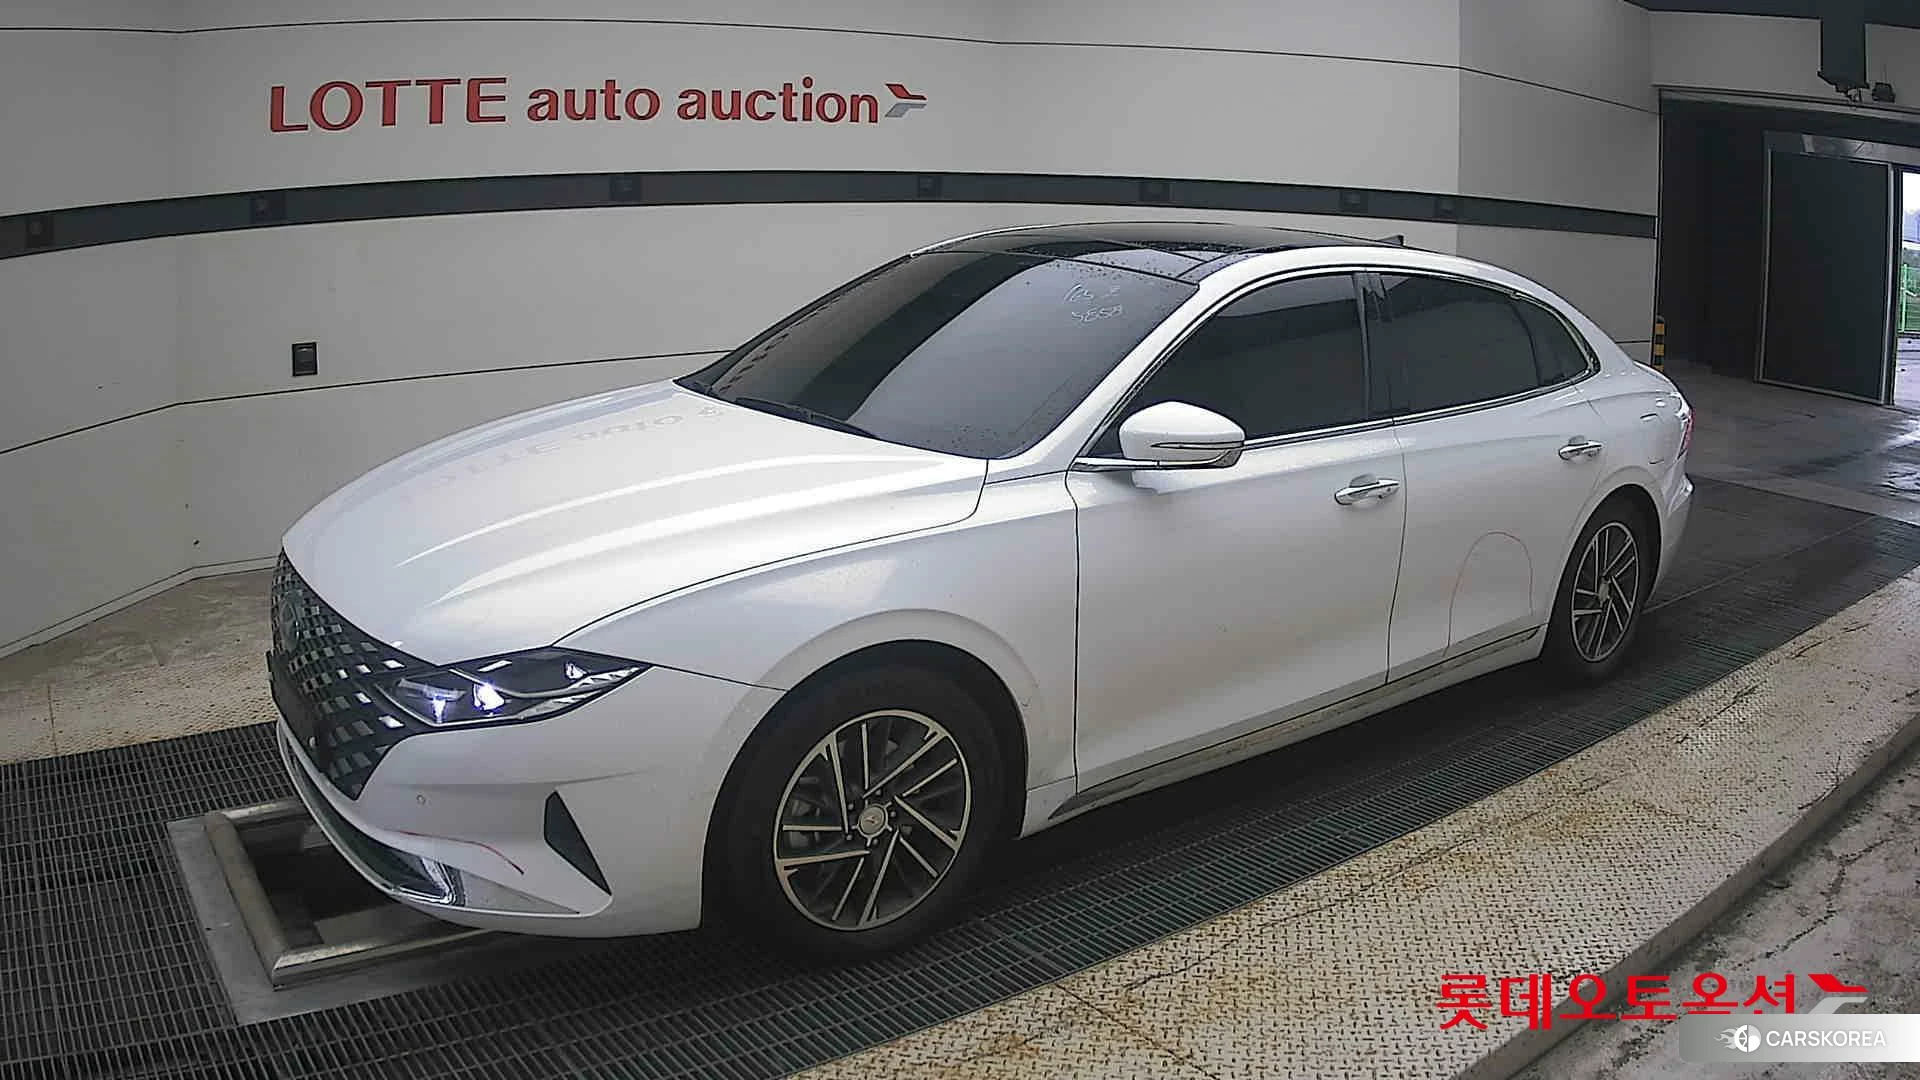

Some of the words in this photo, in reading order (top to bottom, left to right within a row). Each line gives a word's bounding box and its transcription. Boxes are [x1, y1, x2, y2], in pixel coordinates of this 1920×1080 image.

[270, 77, 507, 133] LOTTE
[527, 79, 661, 121] auto
[677, 77, 879, 123] auction
